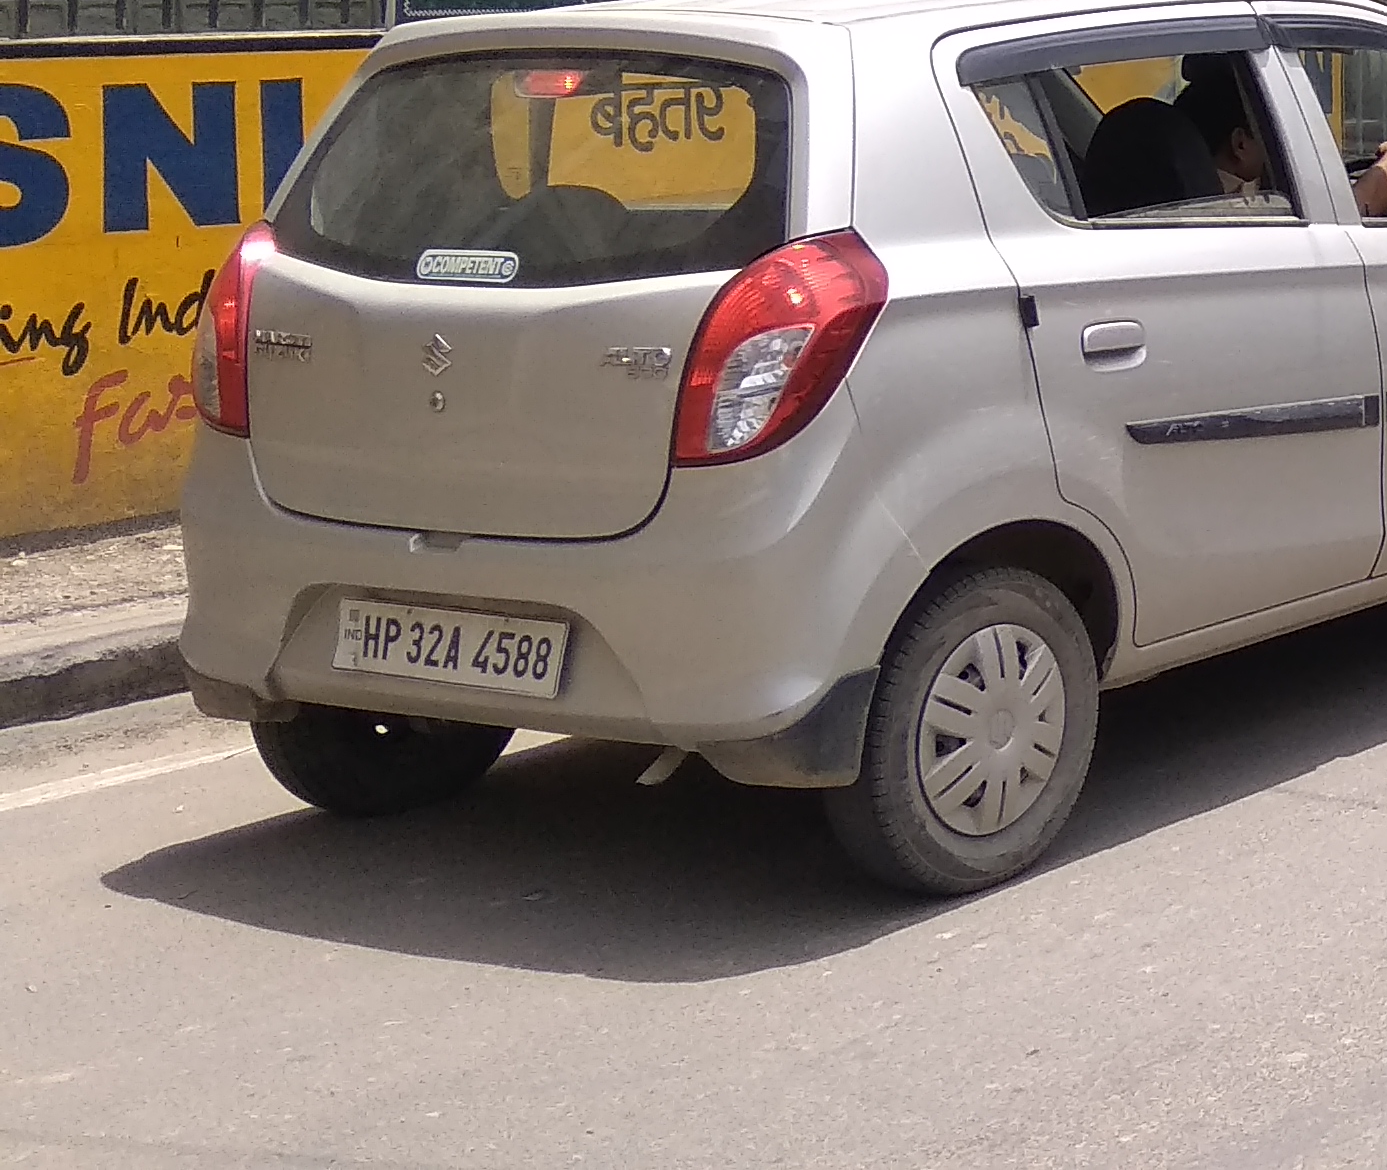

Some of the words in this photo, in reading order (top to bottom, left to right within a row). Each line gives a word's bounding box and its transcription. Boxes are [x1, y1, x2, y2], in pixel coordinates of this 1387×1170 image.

[432, 255, 504, 276] COMPETENT
[362, 614, 402, 662] HP
[405, 620, 463, 671] 32A
[470, 629, 553, 681] 4588
